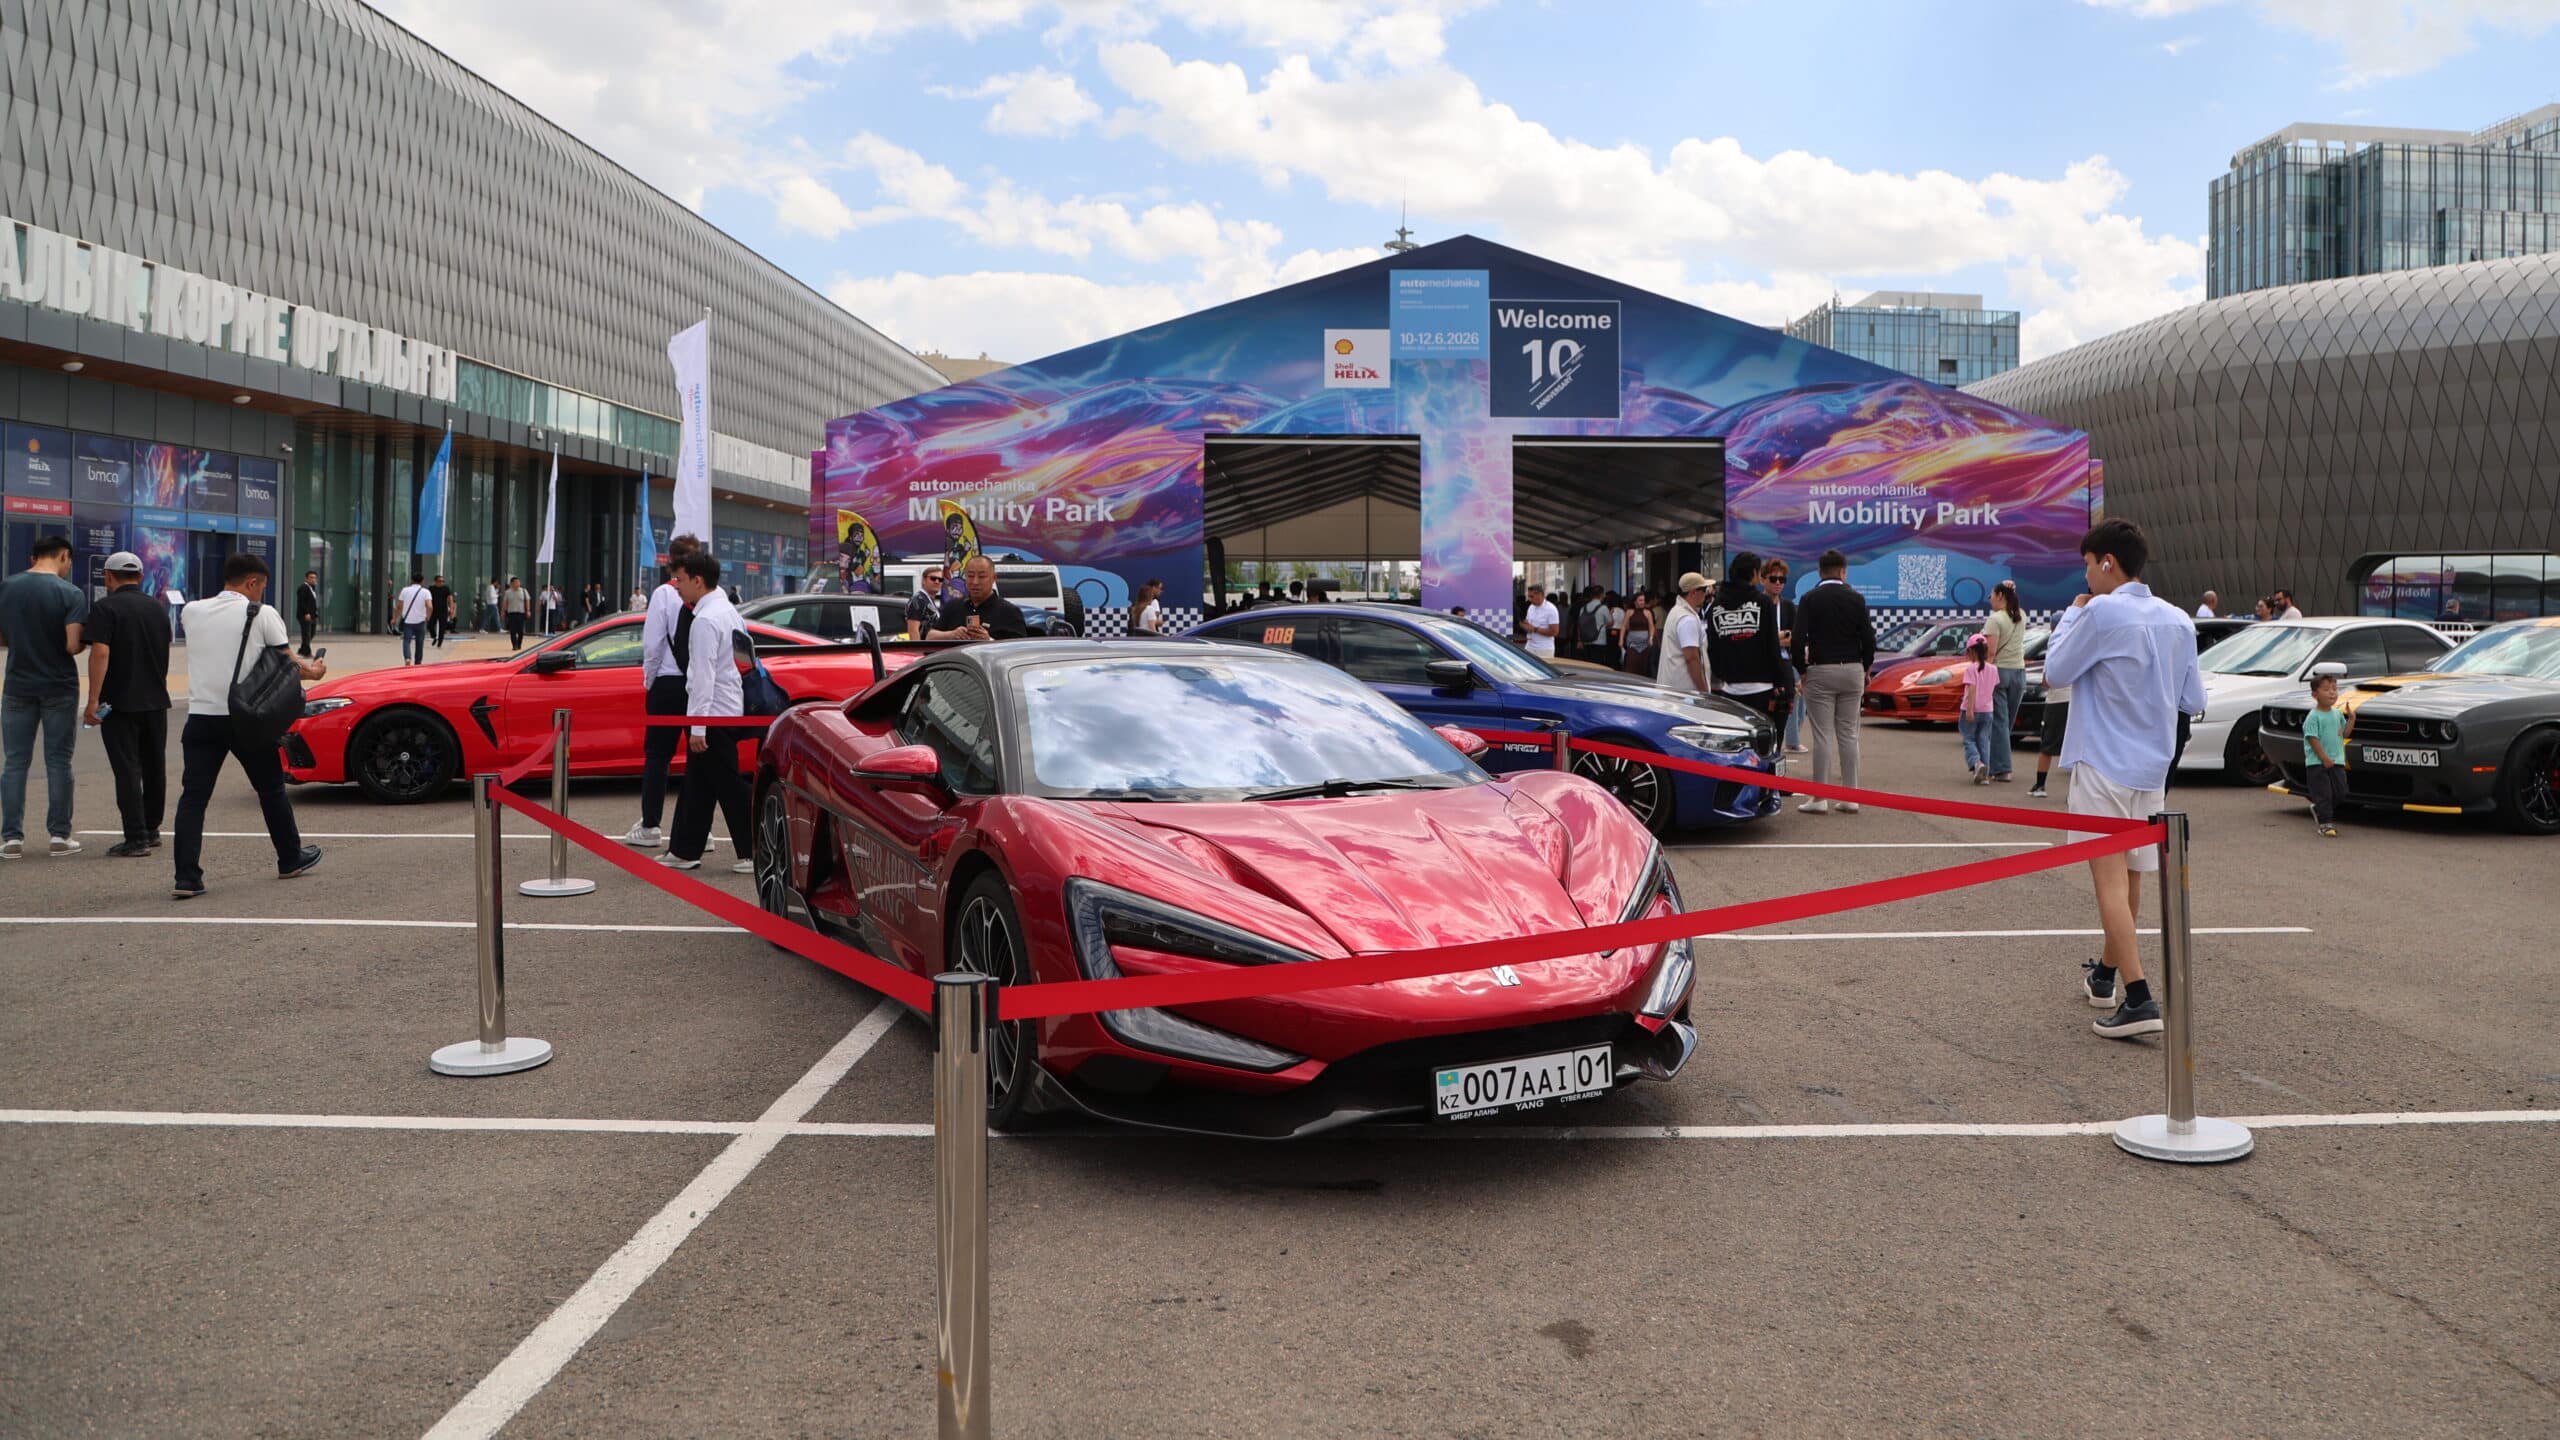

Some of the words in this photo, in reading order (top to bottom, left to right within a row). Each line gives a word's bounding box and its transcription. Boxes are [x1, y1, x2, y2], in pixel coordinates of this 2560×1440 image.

[1400, 278, 1480, 288] automechanika
[1498, 309, 1611, 329] Welcome
[1400, 332, 1480, 345] 10-12.6.2026
[1522, 339, 1580, 384] 10
[1335, 369, 1380, 378] HELIX
[909, 478, 1035, 492] automechanika
[1809, 483, 1927, 496] automechanika
[908, 497, 1035, 528] Mbility
[1046, 497, 1115, 523] Park
[1808, 500, 1927, 530] Mobility
[1937, 501, 2001, 525] Park
[2421, 751, 2437, 765] 01
[1440, 1094, 1460, 1111] KZ
[1464, 1066, 1567, 1105] 007AAI
[1577, 1051, 1609, 1087] 01
[1560, 1093, 1581, 1103] CYBER
[1582, 1090, 1603, 1100] ARENA
[1515, 1100, 1544, 1111] YANG
